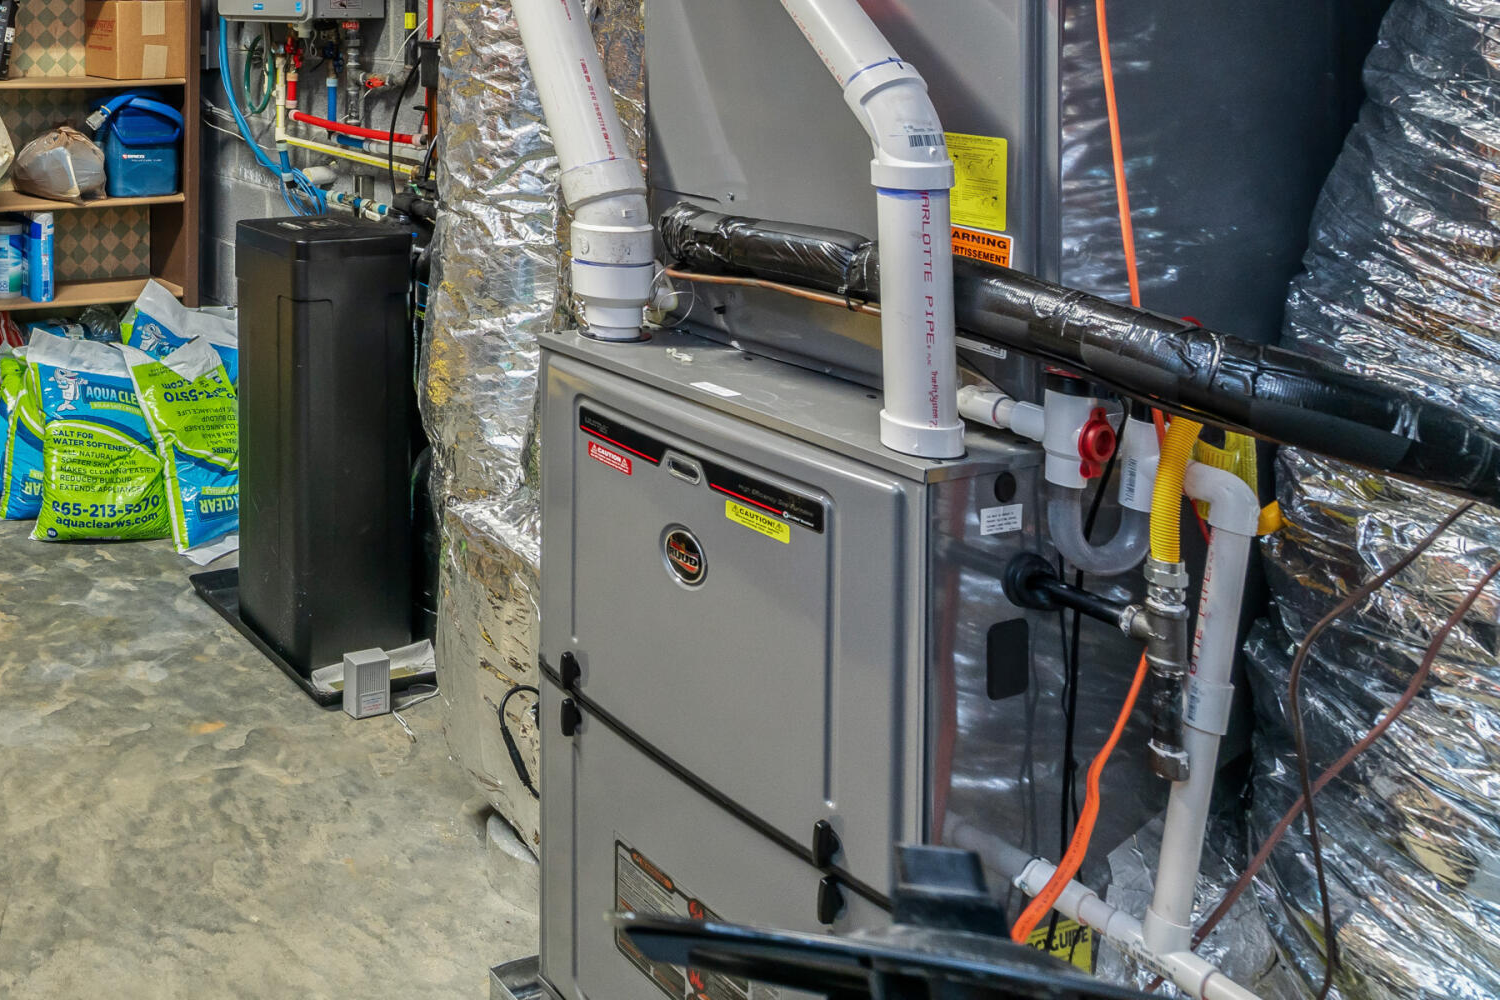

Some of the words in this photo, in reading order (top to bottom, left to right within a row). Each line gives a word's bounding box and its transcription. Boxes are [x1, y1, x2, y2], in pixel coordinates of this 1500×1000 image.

[951, 230, 1007, 250] ARNING
[952, 245, 1007, 265] RTISSEMENT
[924, 294, 936, 345] PIPE
[77, 431, 94, 440] FOR
[53, 438, 85, 447] WATER
[61, 456, 90, 467] SOFTER
[60, 466, 87, 475] MAKES
[89, 467, 128, 475] CLEANING
[59, 474, 97, 484] REDUCED
[59, 483, 96, 492] EXTENDS
[55, 511, 158, 529] aquaclearws.com
[668, 546, 699, 568] RUUD
